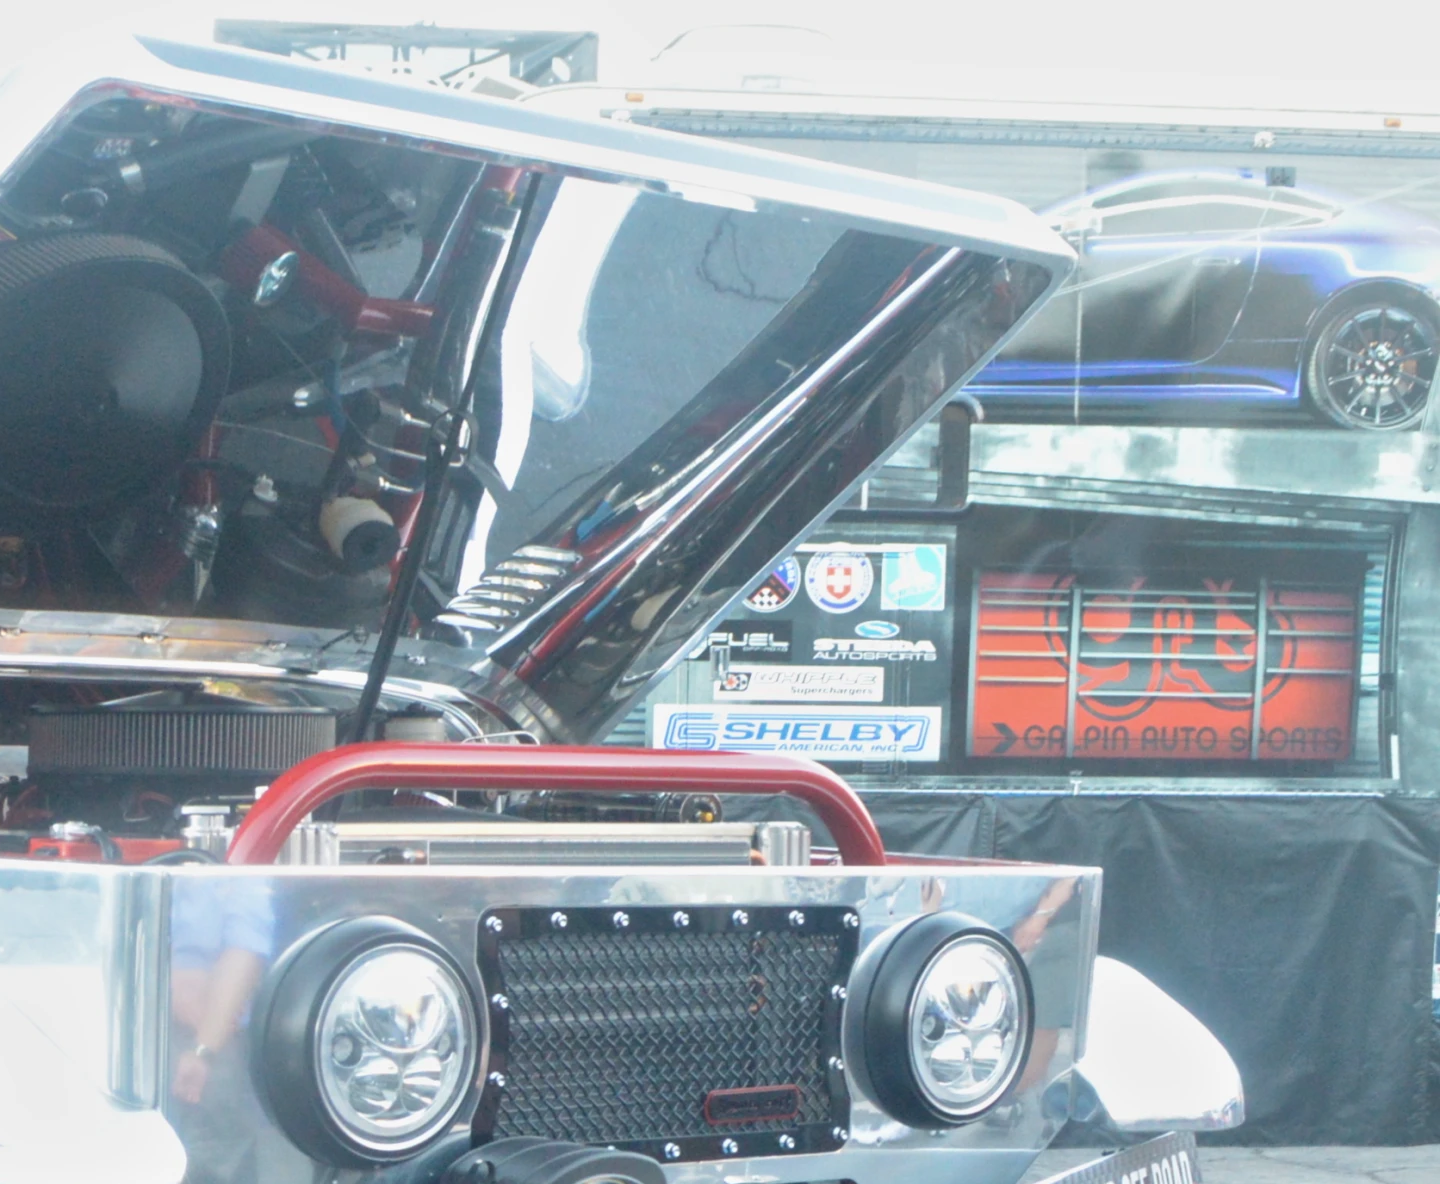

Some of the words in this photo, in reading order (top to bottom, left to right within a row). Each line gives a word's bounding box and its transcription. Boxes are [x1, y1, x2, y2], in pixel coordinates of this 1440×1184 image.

[813, 652, 937, 661] AUTOSPORTS
[755, 672, 878, 684] WHIPPLE
[791, 685, 873, 695] Superchargers
[723, 722, 917, 742] SHELBY
[1141, 725, 1218, 751] AUTO
[1230, 726, 1343, 752] SPORTS
